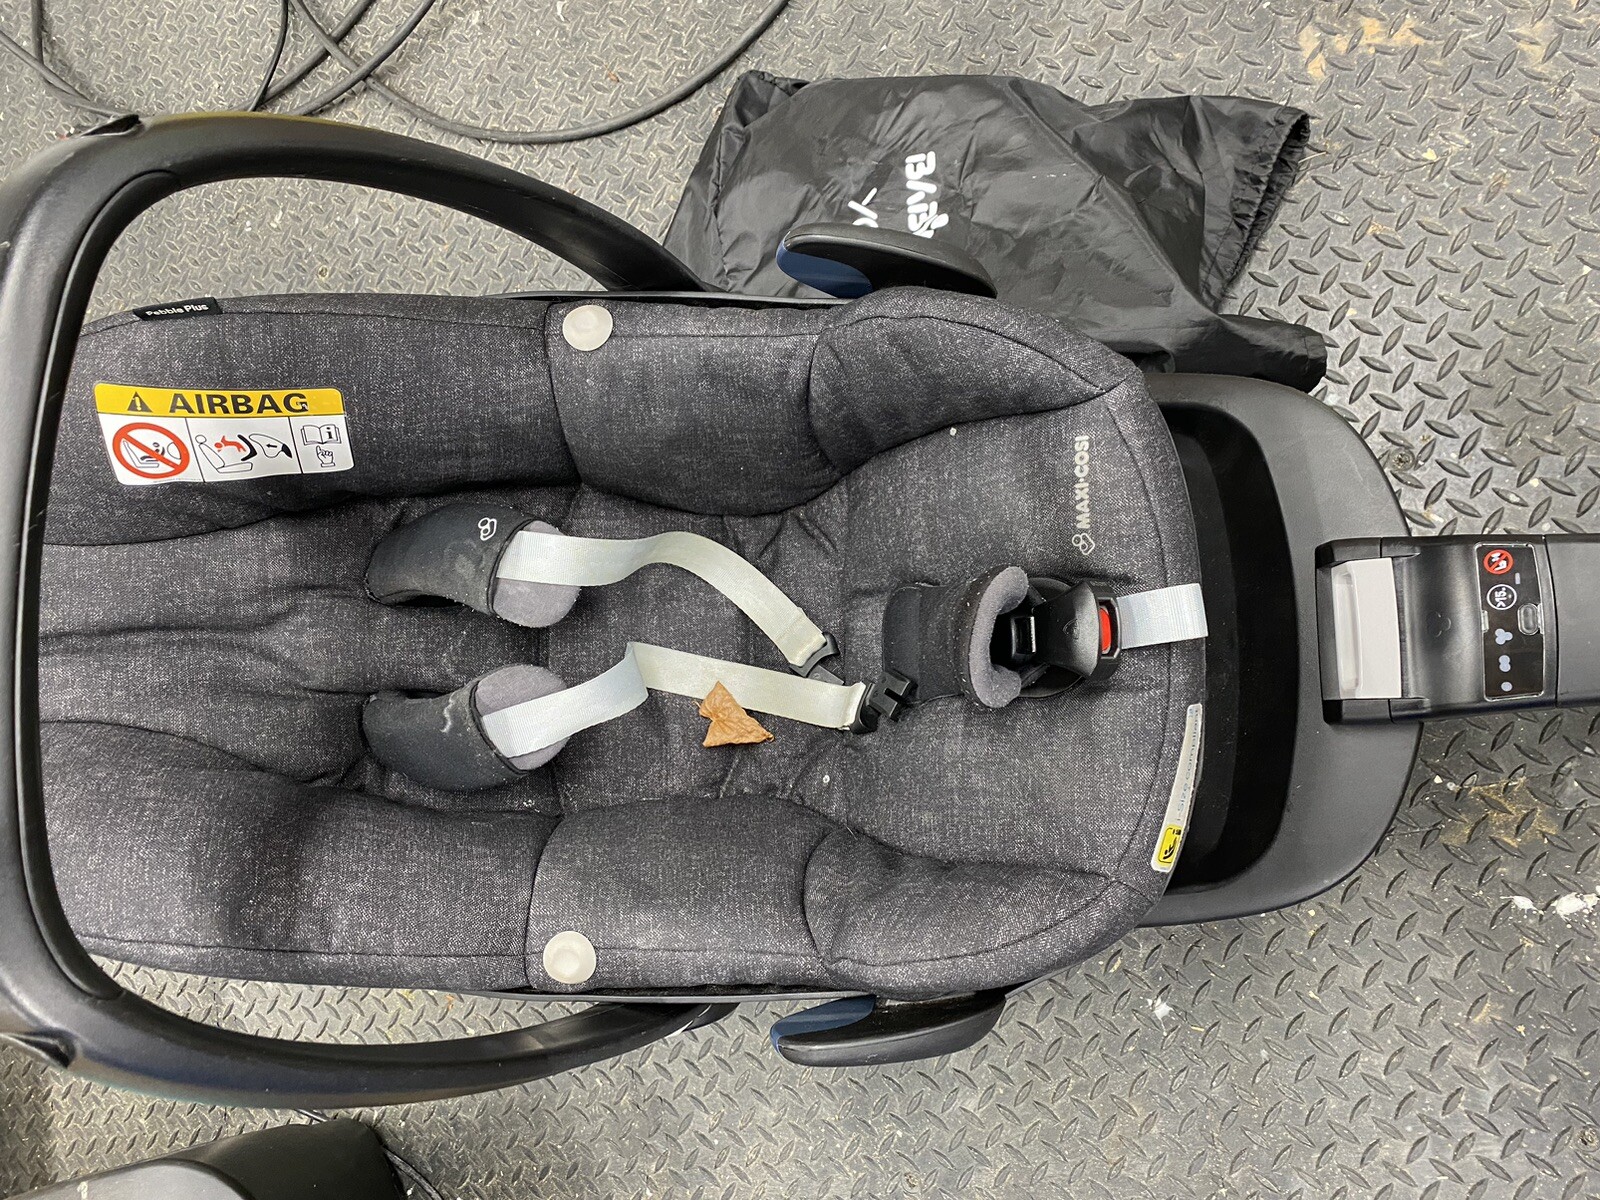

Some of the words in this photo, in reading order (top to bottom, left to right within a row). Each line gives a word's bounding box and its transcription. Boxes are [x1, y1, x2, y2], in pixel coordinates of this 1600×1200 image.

[145, 307, 184, 316] Pebble
[184, 303, 209, 313] Plus
[169, 392, 309, 415] AIRBAG
